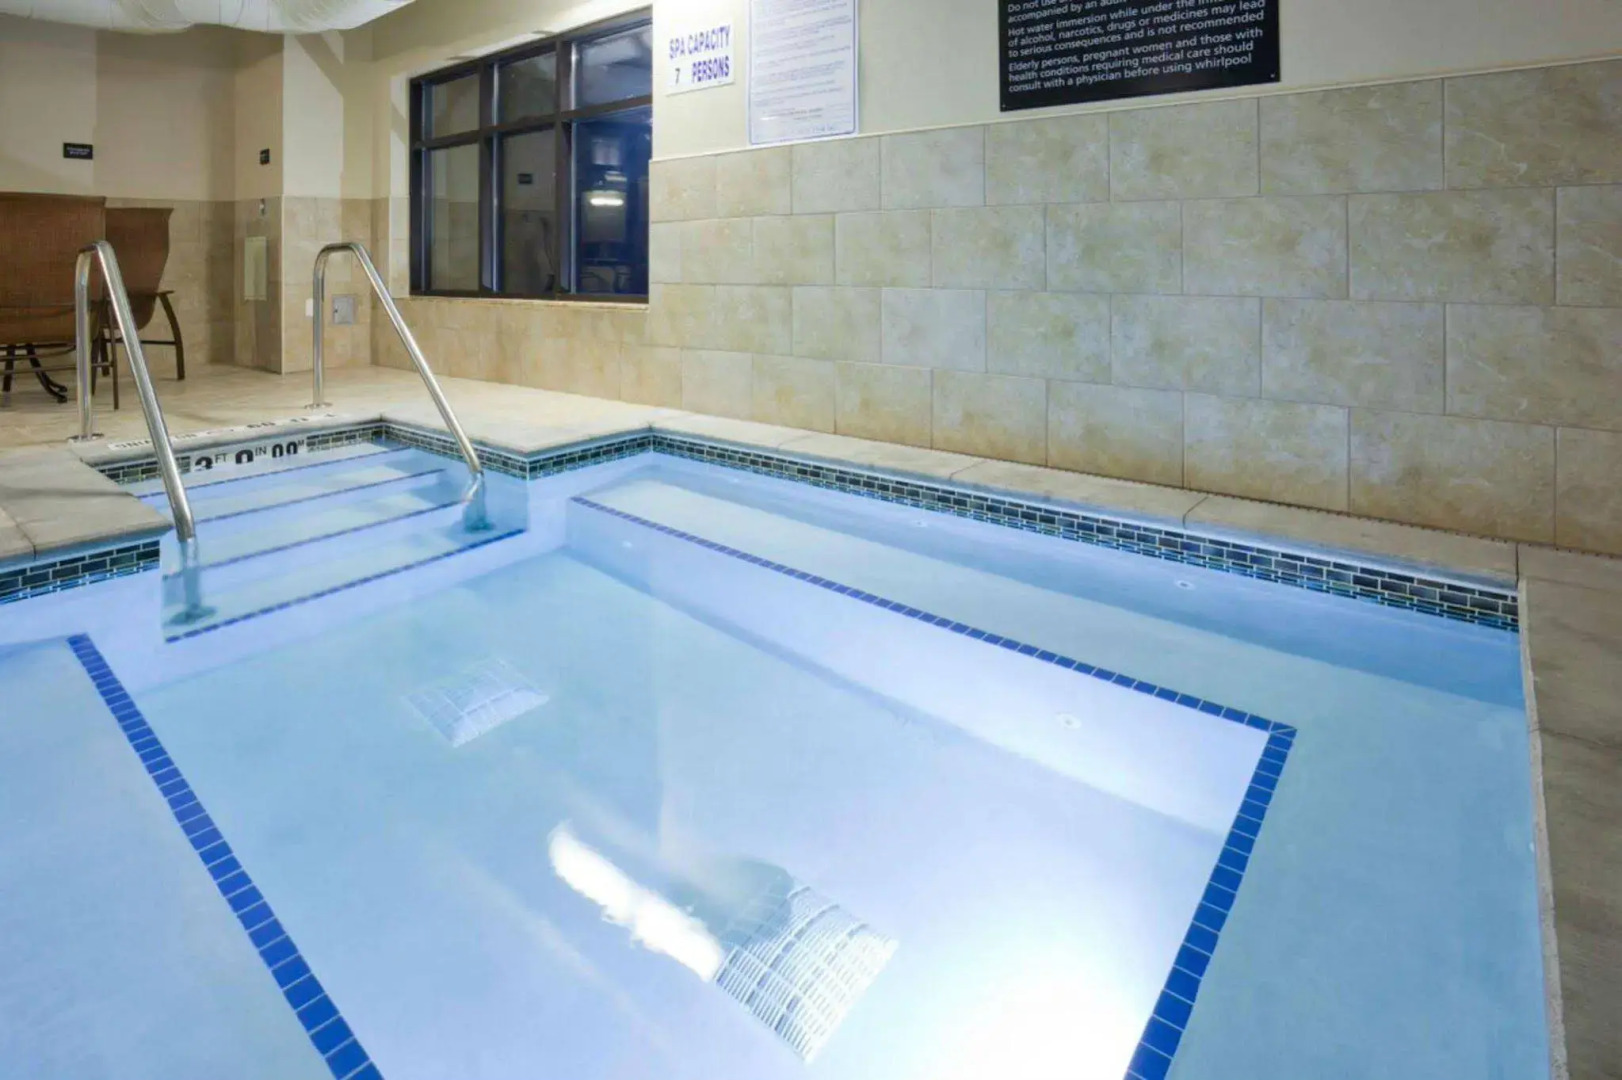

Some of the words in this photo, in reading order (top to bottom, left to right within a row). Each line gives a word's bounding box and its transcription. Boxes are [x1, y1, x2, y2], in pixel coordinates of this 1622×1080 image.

[1008, 4, 1020, 12] Do
[1023, 1, 1039, 9] not
[1008, 5, 1068, 23] accompanied
[1070, 3, 1083, 13] by
[1085, 1, 1098, 9] an
[1008, 27, 1025, 37] Hot
[1026, 23, 1054, 33] water
[1056, 14, 1107, 29] immersion
[1110, 7, 1138, 20] while
[1140, 2, 1173, 15] under
[1176, 0, 1195, 8] the
[1008, 37, 1018, 47] of
[1020, 32, 1056, 45] alcohol,
[1058, 25, 1105, 39] narcotics,
[1107, 18, 1137, 32] drugs
[1139, 18, 1151, 26] or
[1153, 7, 1209, 24] medicines
[1211, 4, 1237, 16] may
[1239, 0, 1266, 11] lead
[669, 34, 686, 60] SPA
[688, 24, 731, 55] CAPACITY
[1008, 50, 1019, 58] to
[1021, 44, 1053, 57] serious
[1054, 33, 1122, 51] consequences
[1124, 29, 1145, 40] and
[1147, 28, 1156, 37] is
[1158, 25, 1177, 36] not
[1179, 10, 1265, 32] recommended
[1009, 60, 1040, 73] Elderly
[1041, 54, 1081, 69] persons,
[1083, 46, 1130, 62] pregnant
[1132, 41, 1173, 55] women
[1175, 36, 1197, 49] and
[1200, 32, 1233, 46] those
[1235, 26, 1264, 40] with
[675, 67, 681, 85] 7
[692, 55, 730, 83] PERSONS
[1008, 80, 1042, 93] consult
[1043, 77, 1066, 89] with
[1067, 78, 1074, 86] a
[1076, 71, 1122, 87] physician
[1124, 66, 1159, 79] before
[1162, 61, 1193, 73] using
[1195, 52, 1252, 69] whirlpool
[1009, 71, 1039, 82] health
[1040, 64, 1090, 78] conditions
[1092, 56, 1139, 73] requiring
[1141, 50, 1184, 65] medical
[1186, 48, 1211, 59] care
[1213, 41, 1254, 56] should
[215, 453, 227, 463] FT
[255, 446, 267, 456] IN
